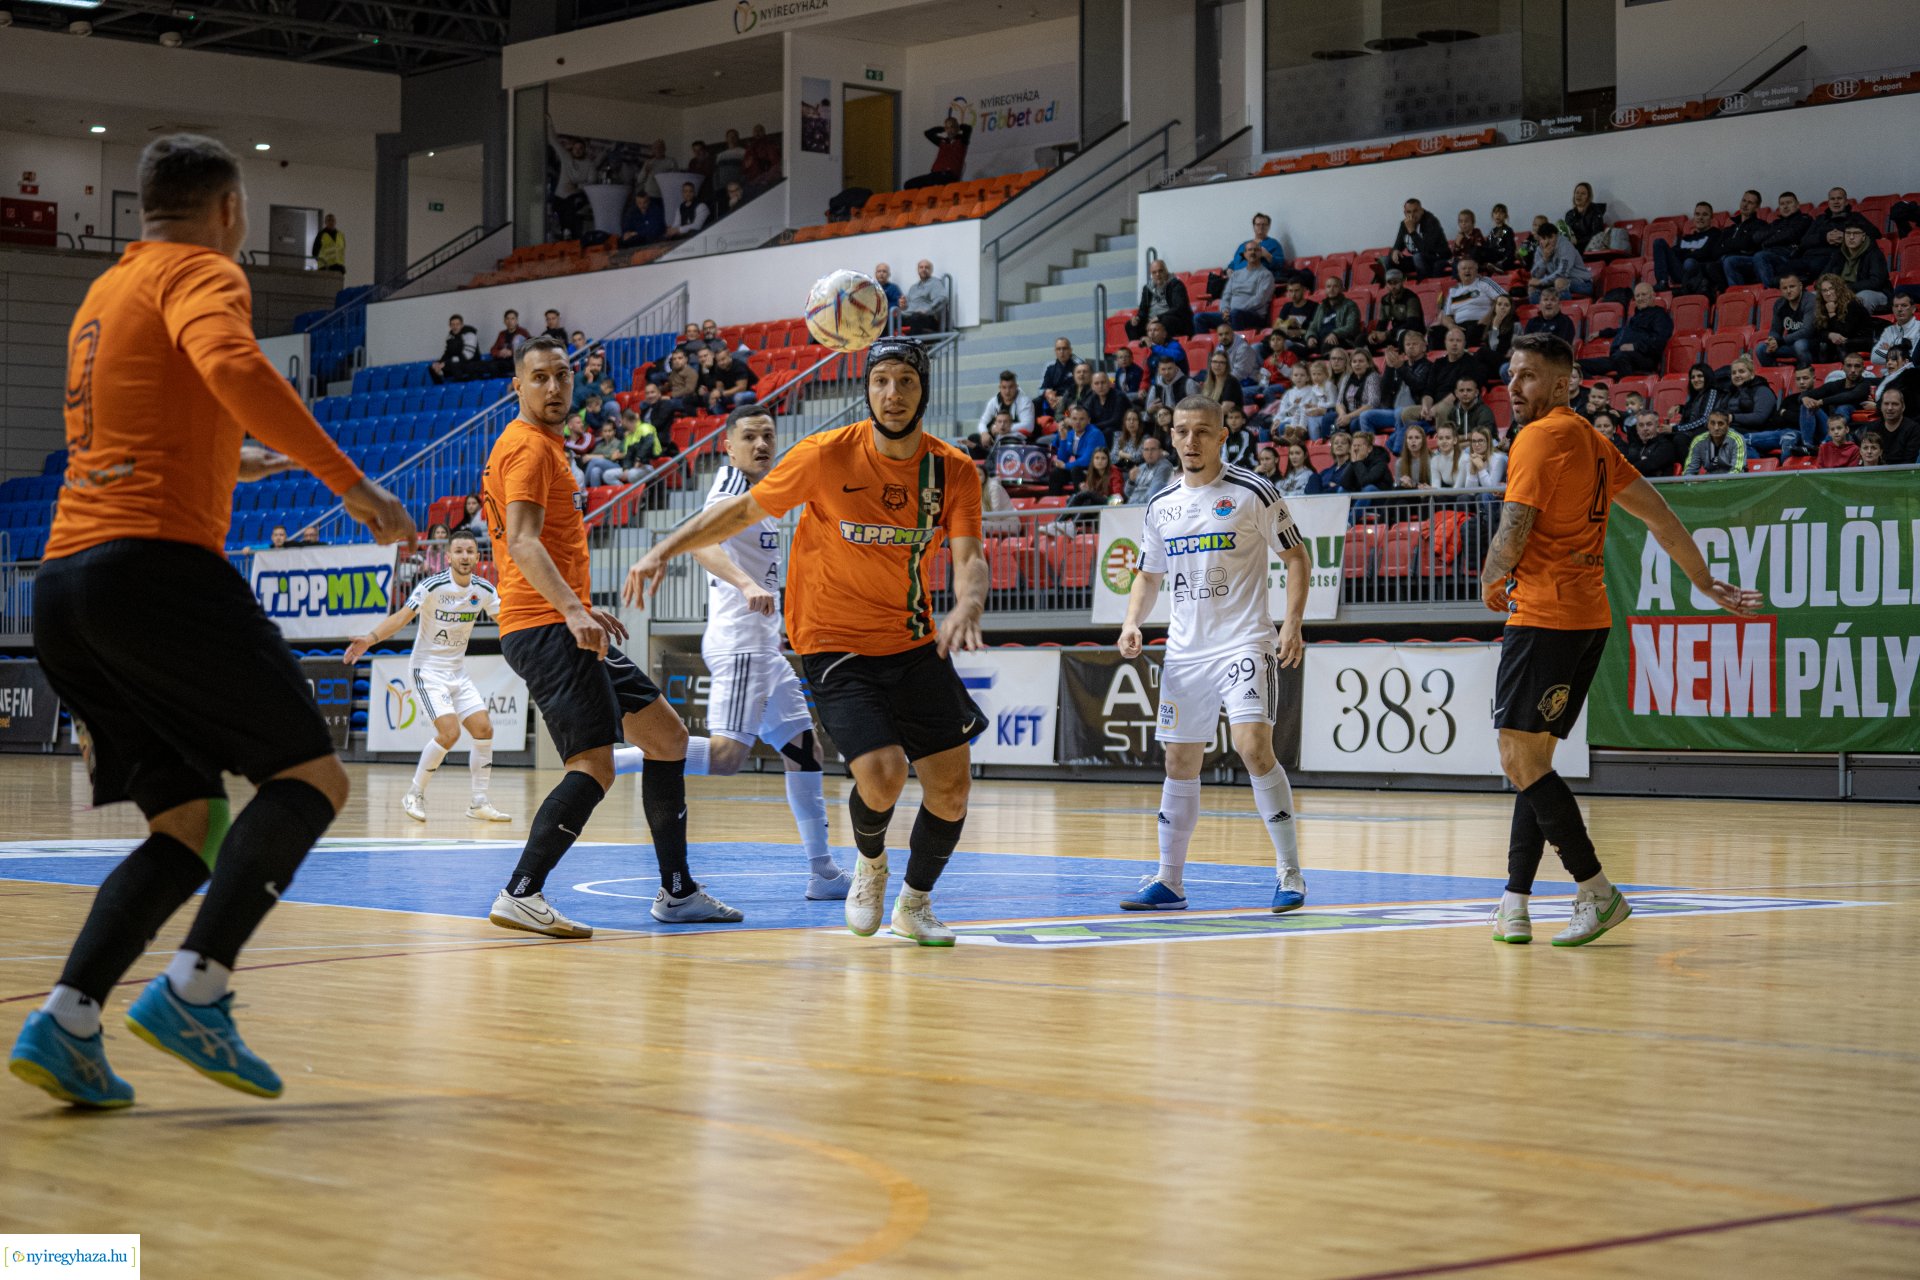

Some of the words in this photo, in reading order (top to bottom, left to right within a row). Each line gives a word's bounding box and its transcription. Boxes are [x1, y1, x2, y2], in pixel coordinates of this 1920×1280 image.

[981, 88, 1040, 108] NYÍREGYHÁZA
[981, 107, 1032, 132] Többet
[1160, 505, 1182, 522] 383
[1636, 528, 1676, 611] A
[1690, 506, 1920, 611] GYŰLÖL
[1228, 657, 1256, 687] 99
[1631, 623, 1771, 718] NEM
[325, 716, 348, 726] KFT
[1332, 667, 1457, 755] 383
[997, 710, 1045, 747] KFT
